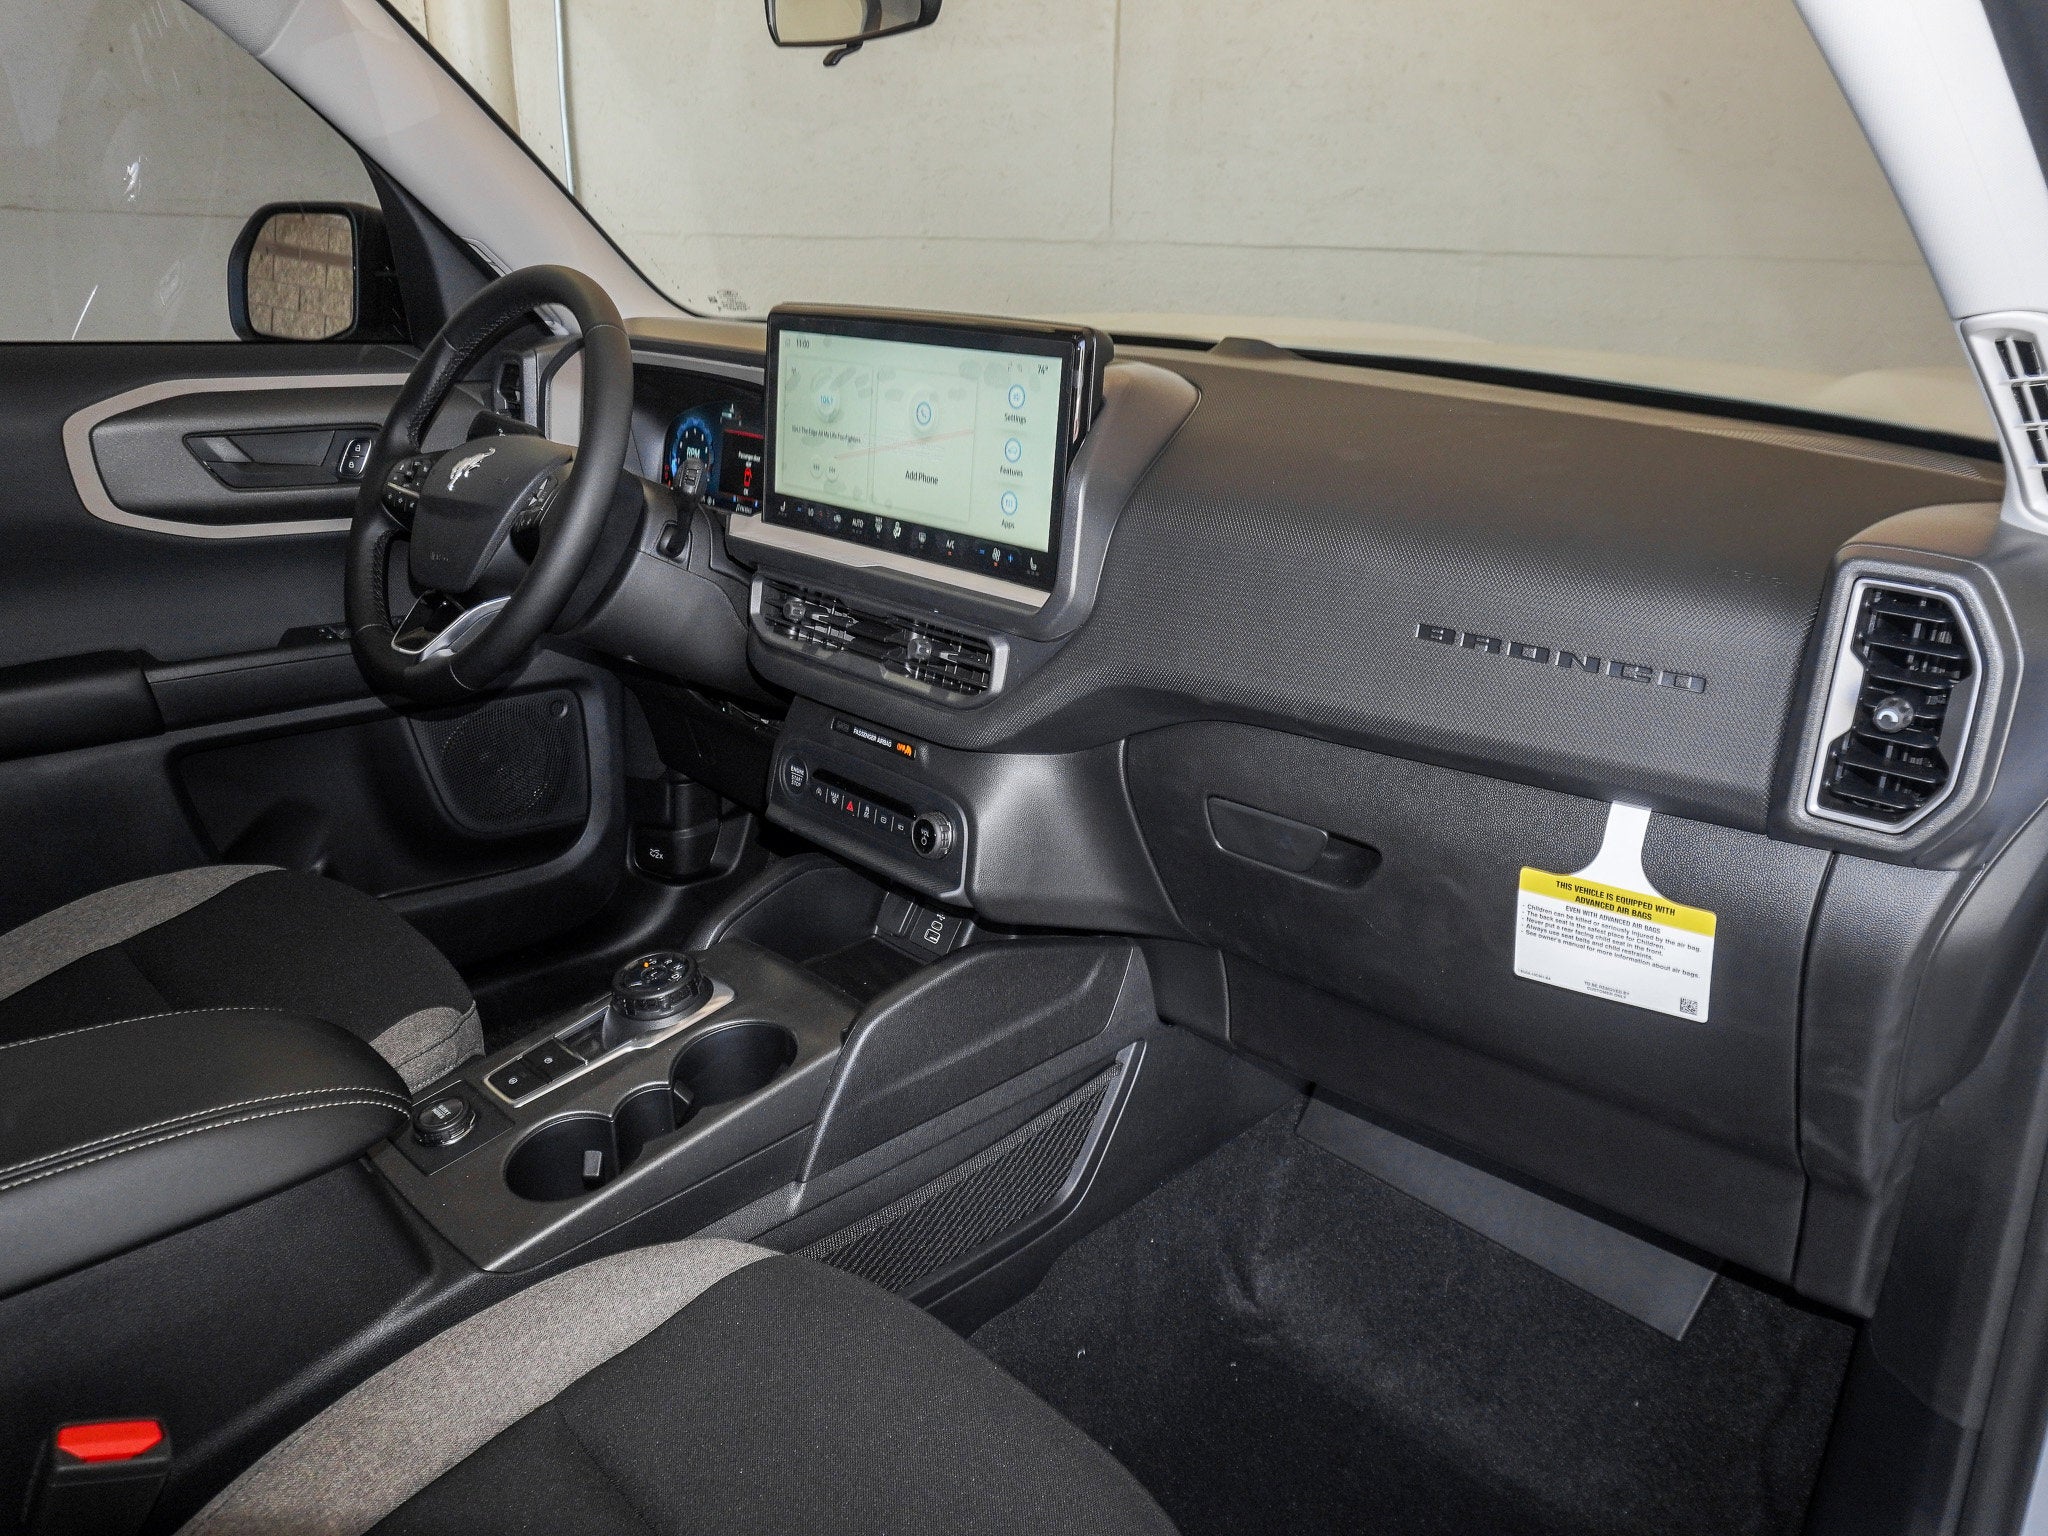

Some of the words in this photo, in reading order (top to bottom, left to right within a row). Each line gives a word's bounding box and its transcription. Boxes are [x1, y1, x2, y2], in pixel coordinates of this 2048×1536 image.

[1004, 412, 1027, 425] Settings
[905, 470, 918, 480] Add
[919, 472, 938, 485] Phone
[1000, 464, 1024, 478] Features
[852, 518, 864, 528] AUTO
[1001, 518, 1015, 530] Apps
[1415, 622, 1707, 695] BRONCO
[852, 728, 877, 742] PASSENGER
[876, 736, 892, 748] AIRBAG
[790, 765, 804, 776] ENGINE
[791, 774, 802, 782] START
[1556, 880, 1572, 891] THIS
[1574, 885, 1604, 898] VEHICLE
[1616, 896, 1652, 910] EQUIPPED
[1655, 904, 1676, 916] WITH
[1575, 896, 1614, 912] ADVANCED
[1617, 906, 1630, 915] AIR
[1632, 910, 1652, 920] BAGS
[1528, 904, 1552, 914] Children
[1576, 916, 1592, 924] killed
[1602, 924, 1630, 936] seriously
[1656, 936, 1664, 944] by
[1665, 938, 1676, 946] the
[1688, 944, 1702, 953] bag.
[1540, 914, 1554, 922] back
[1555, 918, 1568, 926] seat
[1576, 922, 1586, 930] the
[1588, 927, 1606, 936] safest
[1608, 932, 1624, 940] place
[1636, 938, 1666, 950] Children.
[1566, 906, 1580, 914] EVEN
[1582, 910, 1598, 918] WITH
[1600, 914, 1630, 926] ADVANCED
[1632, 922, 1642, 930] AIR
[1644, 925, 1660, 934] BAGS
[1526, 917, 1544, 926] Never
[1576, 930, 1594, 939] facing
[1634, 944, 1644, 952] the
[1646, 947, 1664, 956] front.
[1526, 924, 1548, 934] Always
[1576, 936, 1590, 944] belts
[1605, 944, 1620, 952] child
[1622, 948, 1653, 960] restraints.
[1538, 934, 1561, 944] owner's
[1562, 940, 1586, 950] manual
[1614, 952, 1650, 966] information
[1652, 962, 1670, 971] about
[1682, 970, 1700, 979] bags.
